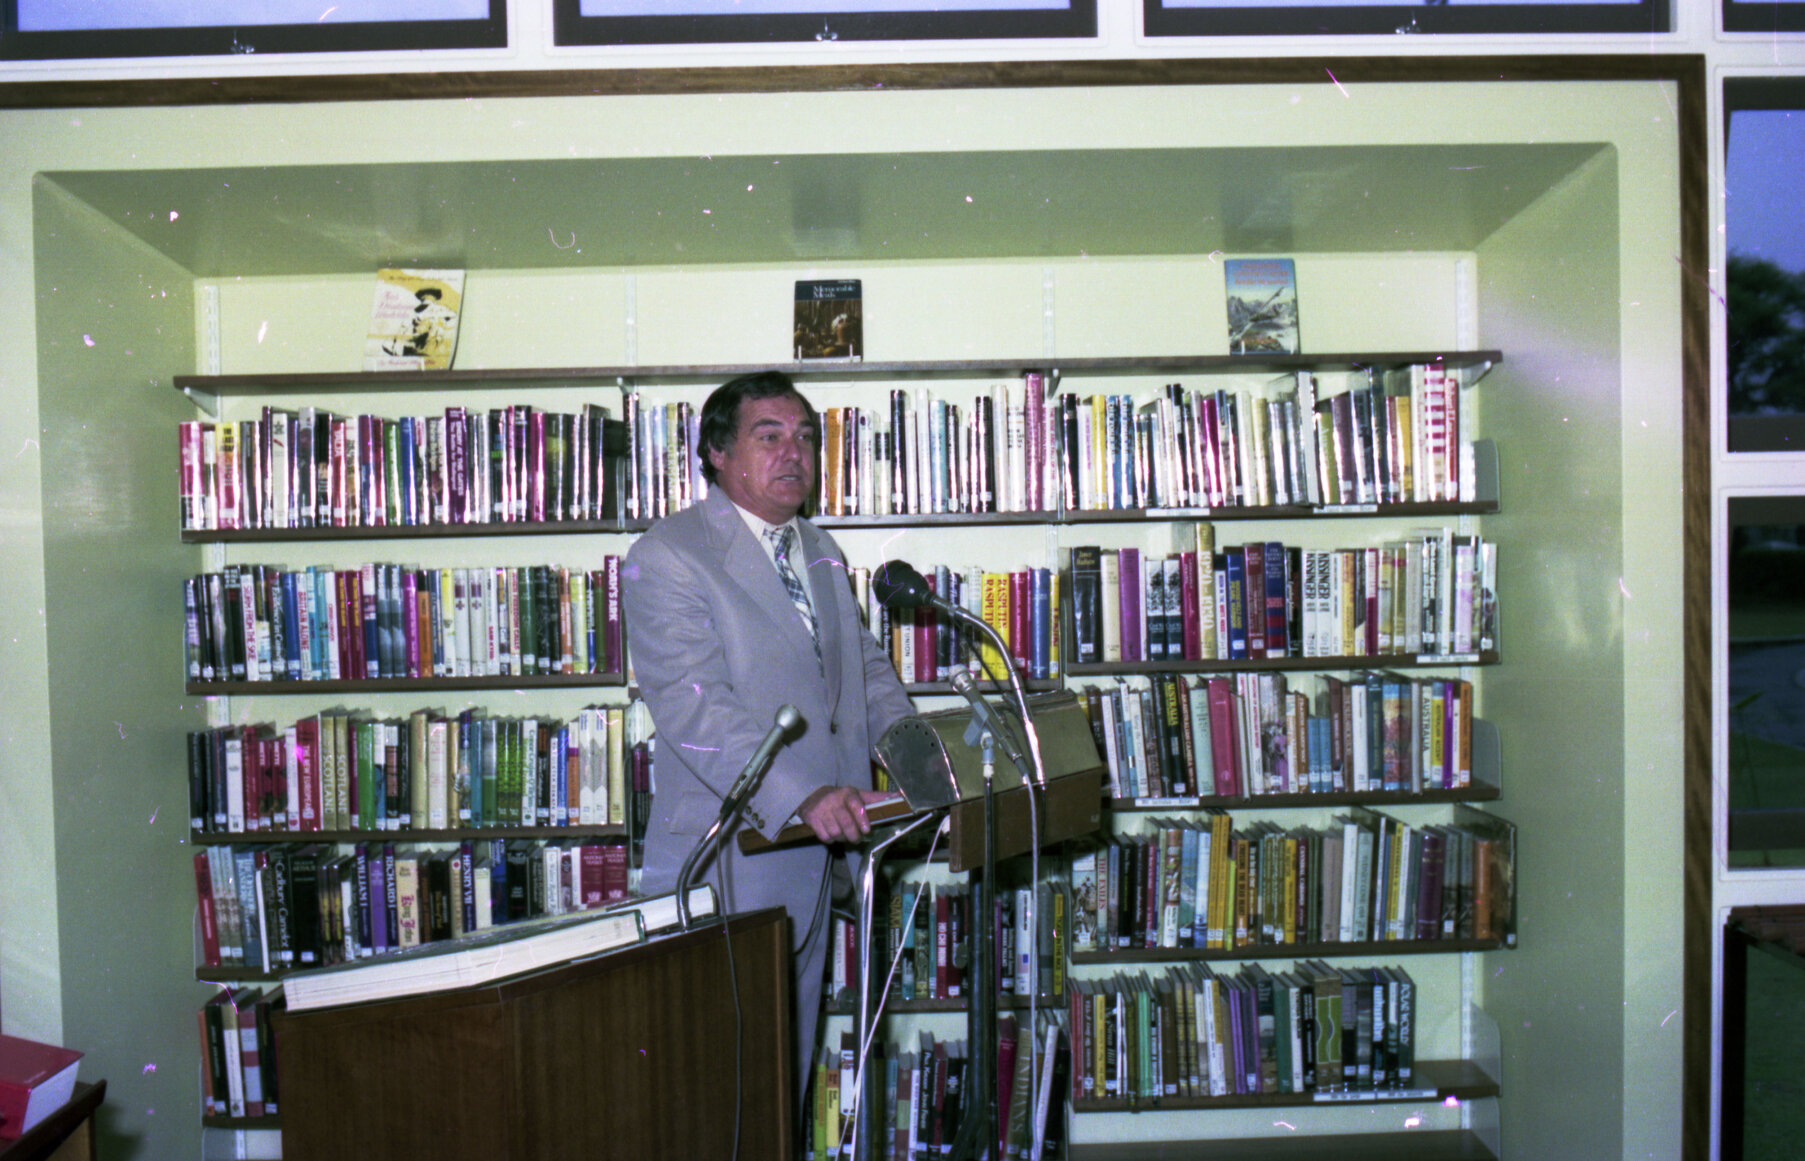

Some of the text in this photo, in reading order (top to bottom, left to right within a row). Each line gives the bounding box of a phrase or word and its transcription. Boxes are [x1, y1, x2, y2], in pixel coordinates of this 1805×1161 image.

[457, 446, 463, 455] AT
[609, 558, 618, 622] NOAH'S ARK
[1306, 553, 1316, 599] KISSINGER
[1318, 553, 1331, 599] KISSINGER
[272, 587, 281, 623] Evidence
[298, 592, 309, 650] BRITAIN ALONE
[247, 631, 255, 645] THE
[274, 625, 281, 633] in
[904, 633, 913, 656] UNION
[1168, 682, 1178, 726] AUSTRALIA
[323, 754, 333, 814] SCOTLAND
[337, 754, 346, 814] SCOTLAND
[357, 856, 367, 901] WILLIAM
[385, 856, 395, 903] RICHARD
[463, 855, 472, 889] HENRY
[275, 862, 290, 948] Cadbury Camelot
[890, 895, 901, 928] SIAM
[938, 922, 946, 967] HO CHI MINH
[1400, 984, 1410, 1011] POLAR
[1011, 1055, 1031, 1131] INDIANS
